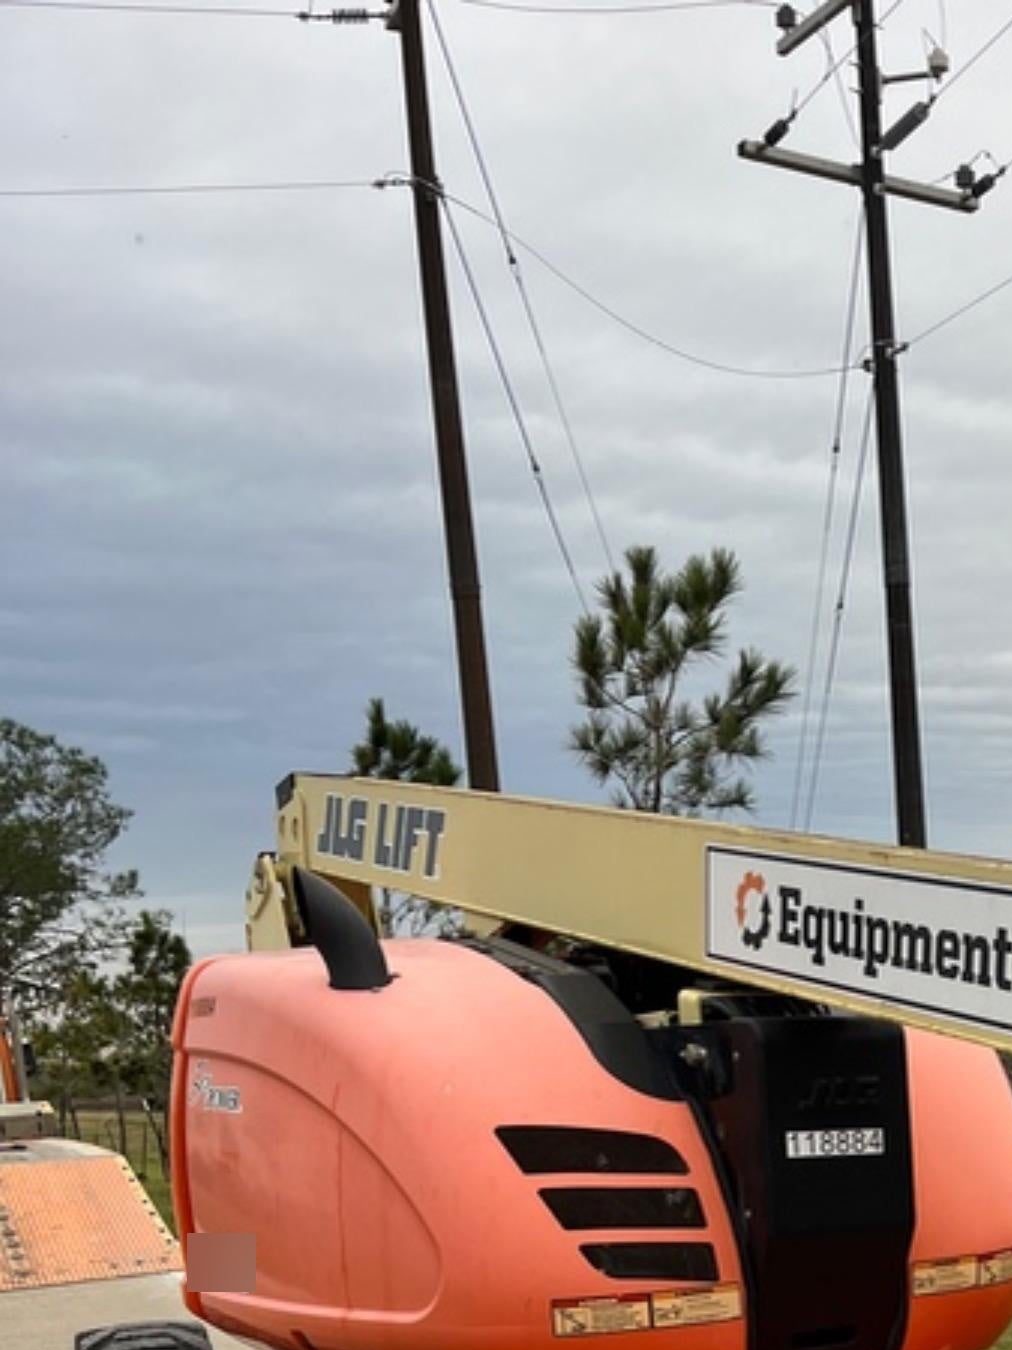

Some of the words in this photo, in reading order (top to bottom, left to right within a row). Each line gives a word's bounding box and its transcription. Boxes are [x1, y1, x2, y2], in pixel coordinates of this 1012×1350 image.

[316, 793, 367, 862] JLG
[373, 802, 446, 878] LIFT
[787, 1130, 882, 1157] 118884
